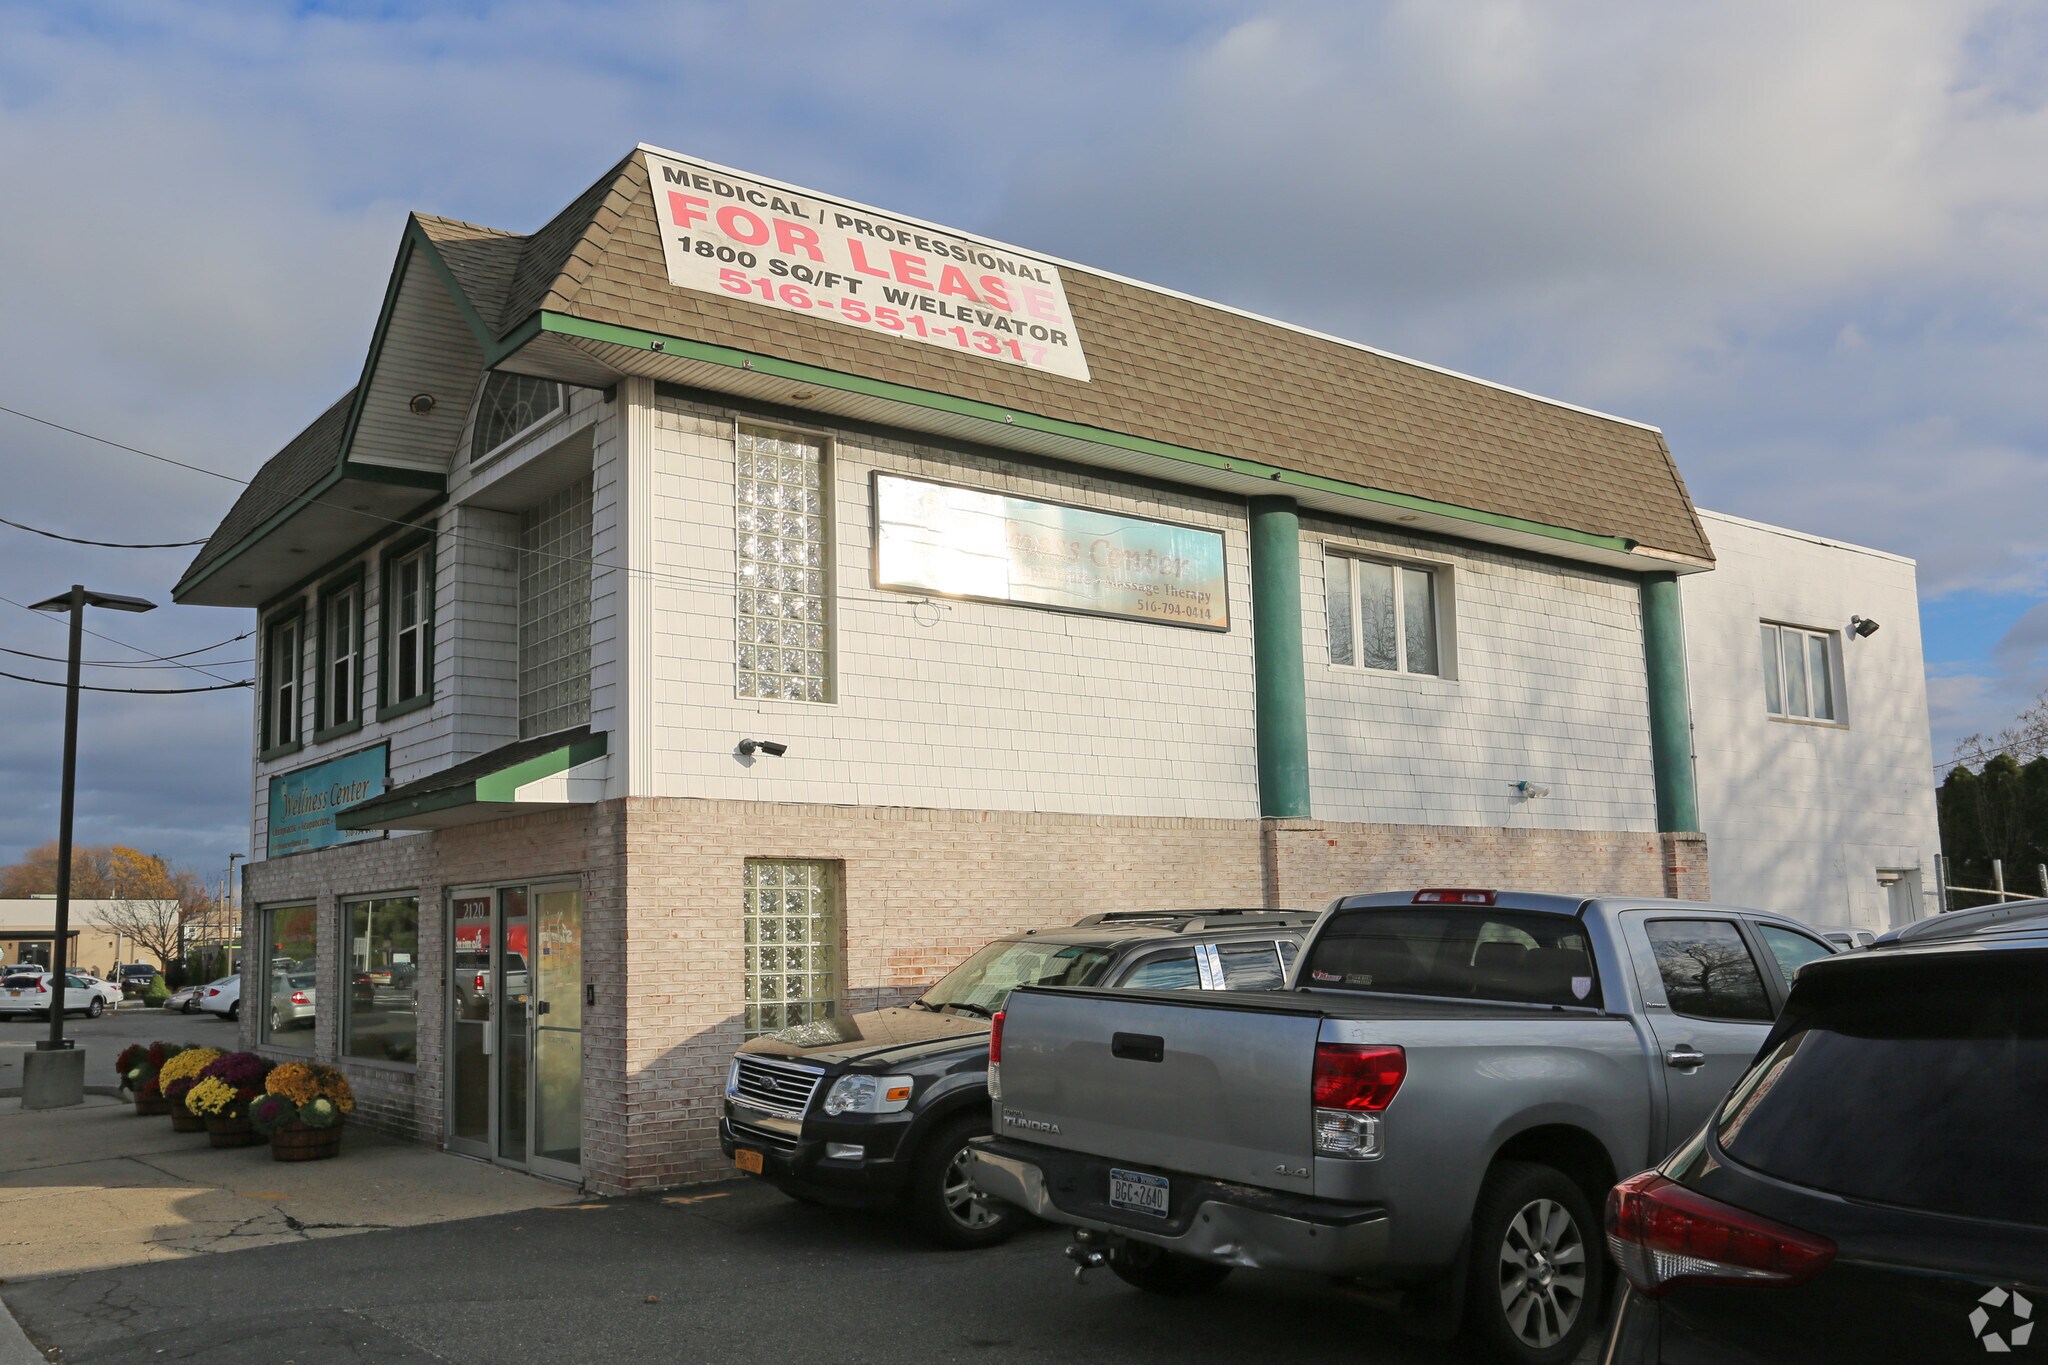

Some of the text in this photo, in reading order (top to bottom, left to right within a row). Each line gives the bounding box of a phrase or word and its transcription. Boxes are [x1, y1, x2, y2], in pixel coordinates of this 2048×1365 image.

[662, 165, 810, 219] MEDICAL
[835, 213, 1051, 285] PROFESSIONAL
[667, 190, 1064, 324] FOR LEASE
[677, 236, 1068, 347] 1800 SQ/FT W/ELEVATOR
[718, 267, 1048, 365] 516-551-1317
[1090, 539, 1190, 577] Center
[1107, 575, 1159, 597] Massage
[1164, 584, 1211, 604] Therapy
[1137, 600, 1211, 620] 516-794-0414
[282, 780, 369, 823] Wellness Center
[464, 902, 484, 919] 2120
[1003, 1116, 1062, 1135] TUNDRA
[1274, 1164, 1310, 1179] 4x4
